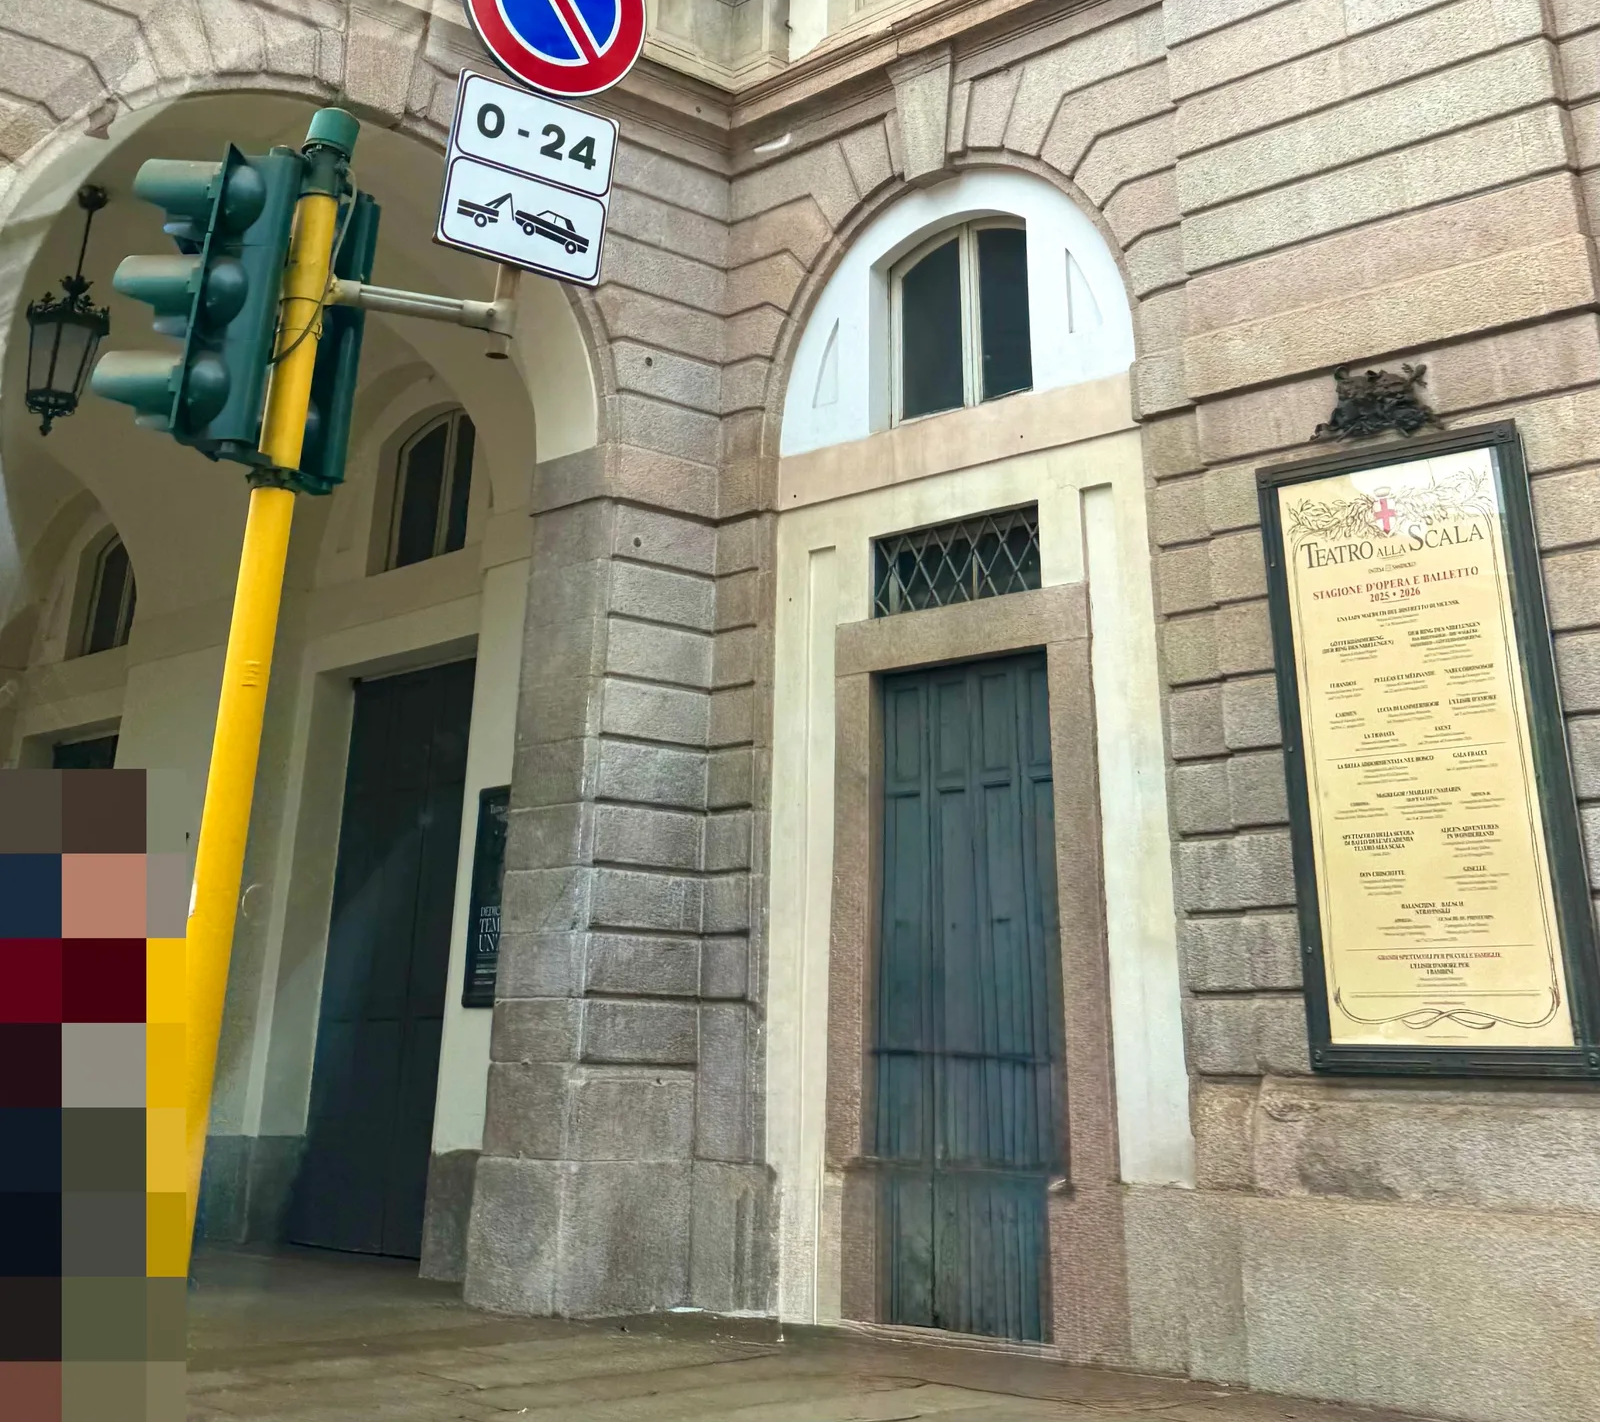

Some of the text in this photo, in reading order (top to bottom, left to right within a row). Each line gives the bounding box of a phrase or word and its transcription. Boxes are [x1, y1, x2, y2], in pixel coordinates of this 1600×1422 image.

[477, 103, 505, 138] 0
[540, 123, 597, 170] 24
[1300, 523, 1485, 569] TEATRO ALLA SCALA
[1313, 566, 1479, 601] STAGIONE D'OPERA E BALLETTO
[1370, 592, 1391, 603] 2025
[1400, 587, 1421, 598] 2026
